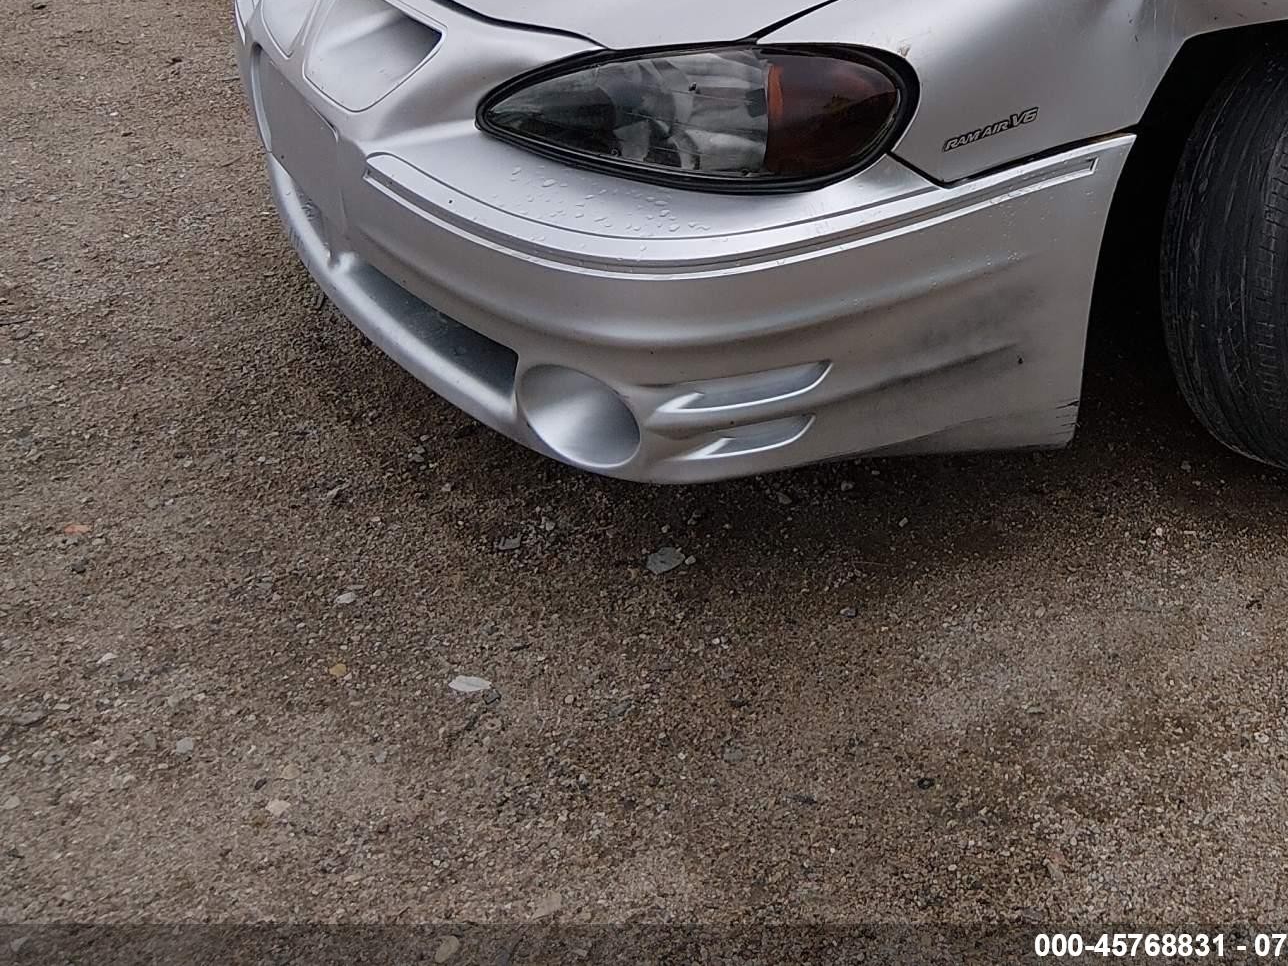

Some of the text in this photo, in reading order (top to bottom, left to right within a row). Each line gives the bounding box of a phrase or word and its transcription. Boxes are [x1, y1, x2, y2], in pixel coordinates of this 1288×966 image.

[943, 107, 1039, 152] RAM AIR V6
